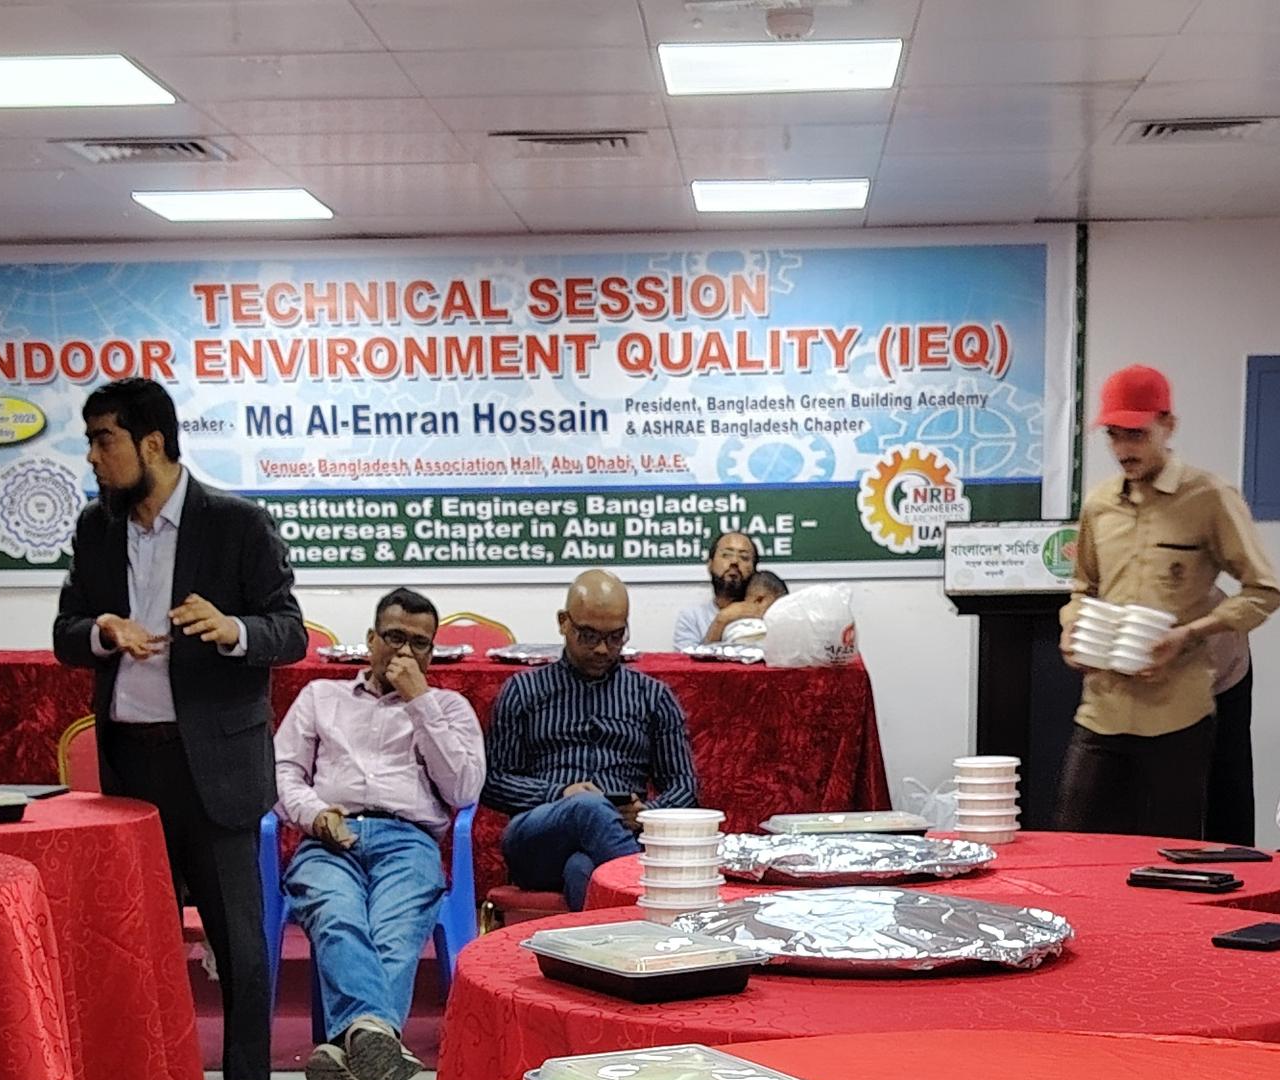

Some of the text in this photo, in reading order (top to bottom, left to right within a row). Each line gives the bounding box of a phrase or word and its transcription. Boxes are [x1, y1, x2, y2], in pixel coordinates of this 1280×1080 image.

[192, 272, 769, 326] TECHNICAL SESSION
[193, 333, 599, 379] ENVIRONMENT
[616, 327, 859, 377] QUALITY
[878, 323, 1010, 380] (IEQ)
[624, 390, 989, 414] President, Bangladesh Green Building Academy
[180, 417, 225, 432] eaker
[245, 404, 294, 437] Md
[306, 403, 459, 436] Al-Emran
[473, 401, 609, 434] Hossain
[624, 416, 865, 437] & ASHRAE Bangladesh Chapter
[260, 459, 314, 476] Venue:
[318, 457, 410, 480] Bangladesh
[414, 456, 506, 475] Association
[551, 454, 582, 471] Abu
[586, 453, 636, 475] Dhabi,
[640, 453, 688, 470] U.A.E.
[404, 497, 434, 518] of
[441, 496, 579, 521] Engineers
[586, 493, 747, 518] Bangladesh
[904, 503, 965, 514] ENGINEERS
[912, 487, 956, 503] NRB
[279, 520, 408, 541] Overseas
[414, 519, 524, 543] Chapter
[530, 517, 557, 538] in
[562, 516, 617, 537] Abu
[624, 515, 712, 539] Dhabi,
[718, 513, 795, 535] U.A.E
[918, 525, 942, 540] UA
[287, 545, 368, 563] neers
[373, 541, 397, 562] &
[403, 540, 555, 564] Architects,
[561, 540, 616, 560] Abu
[622, 537, 710, 562] Dhabi,
[951, 540, 1040, 557] বাংলাদেশ সমিতি
